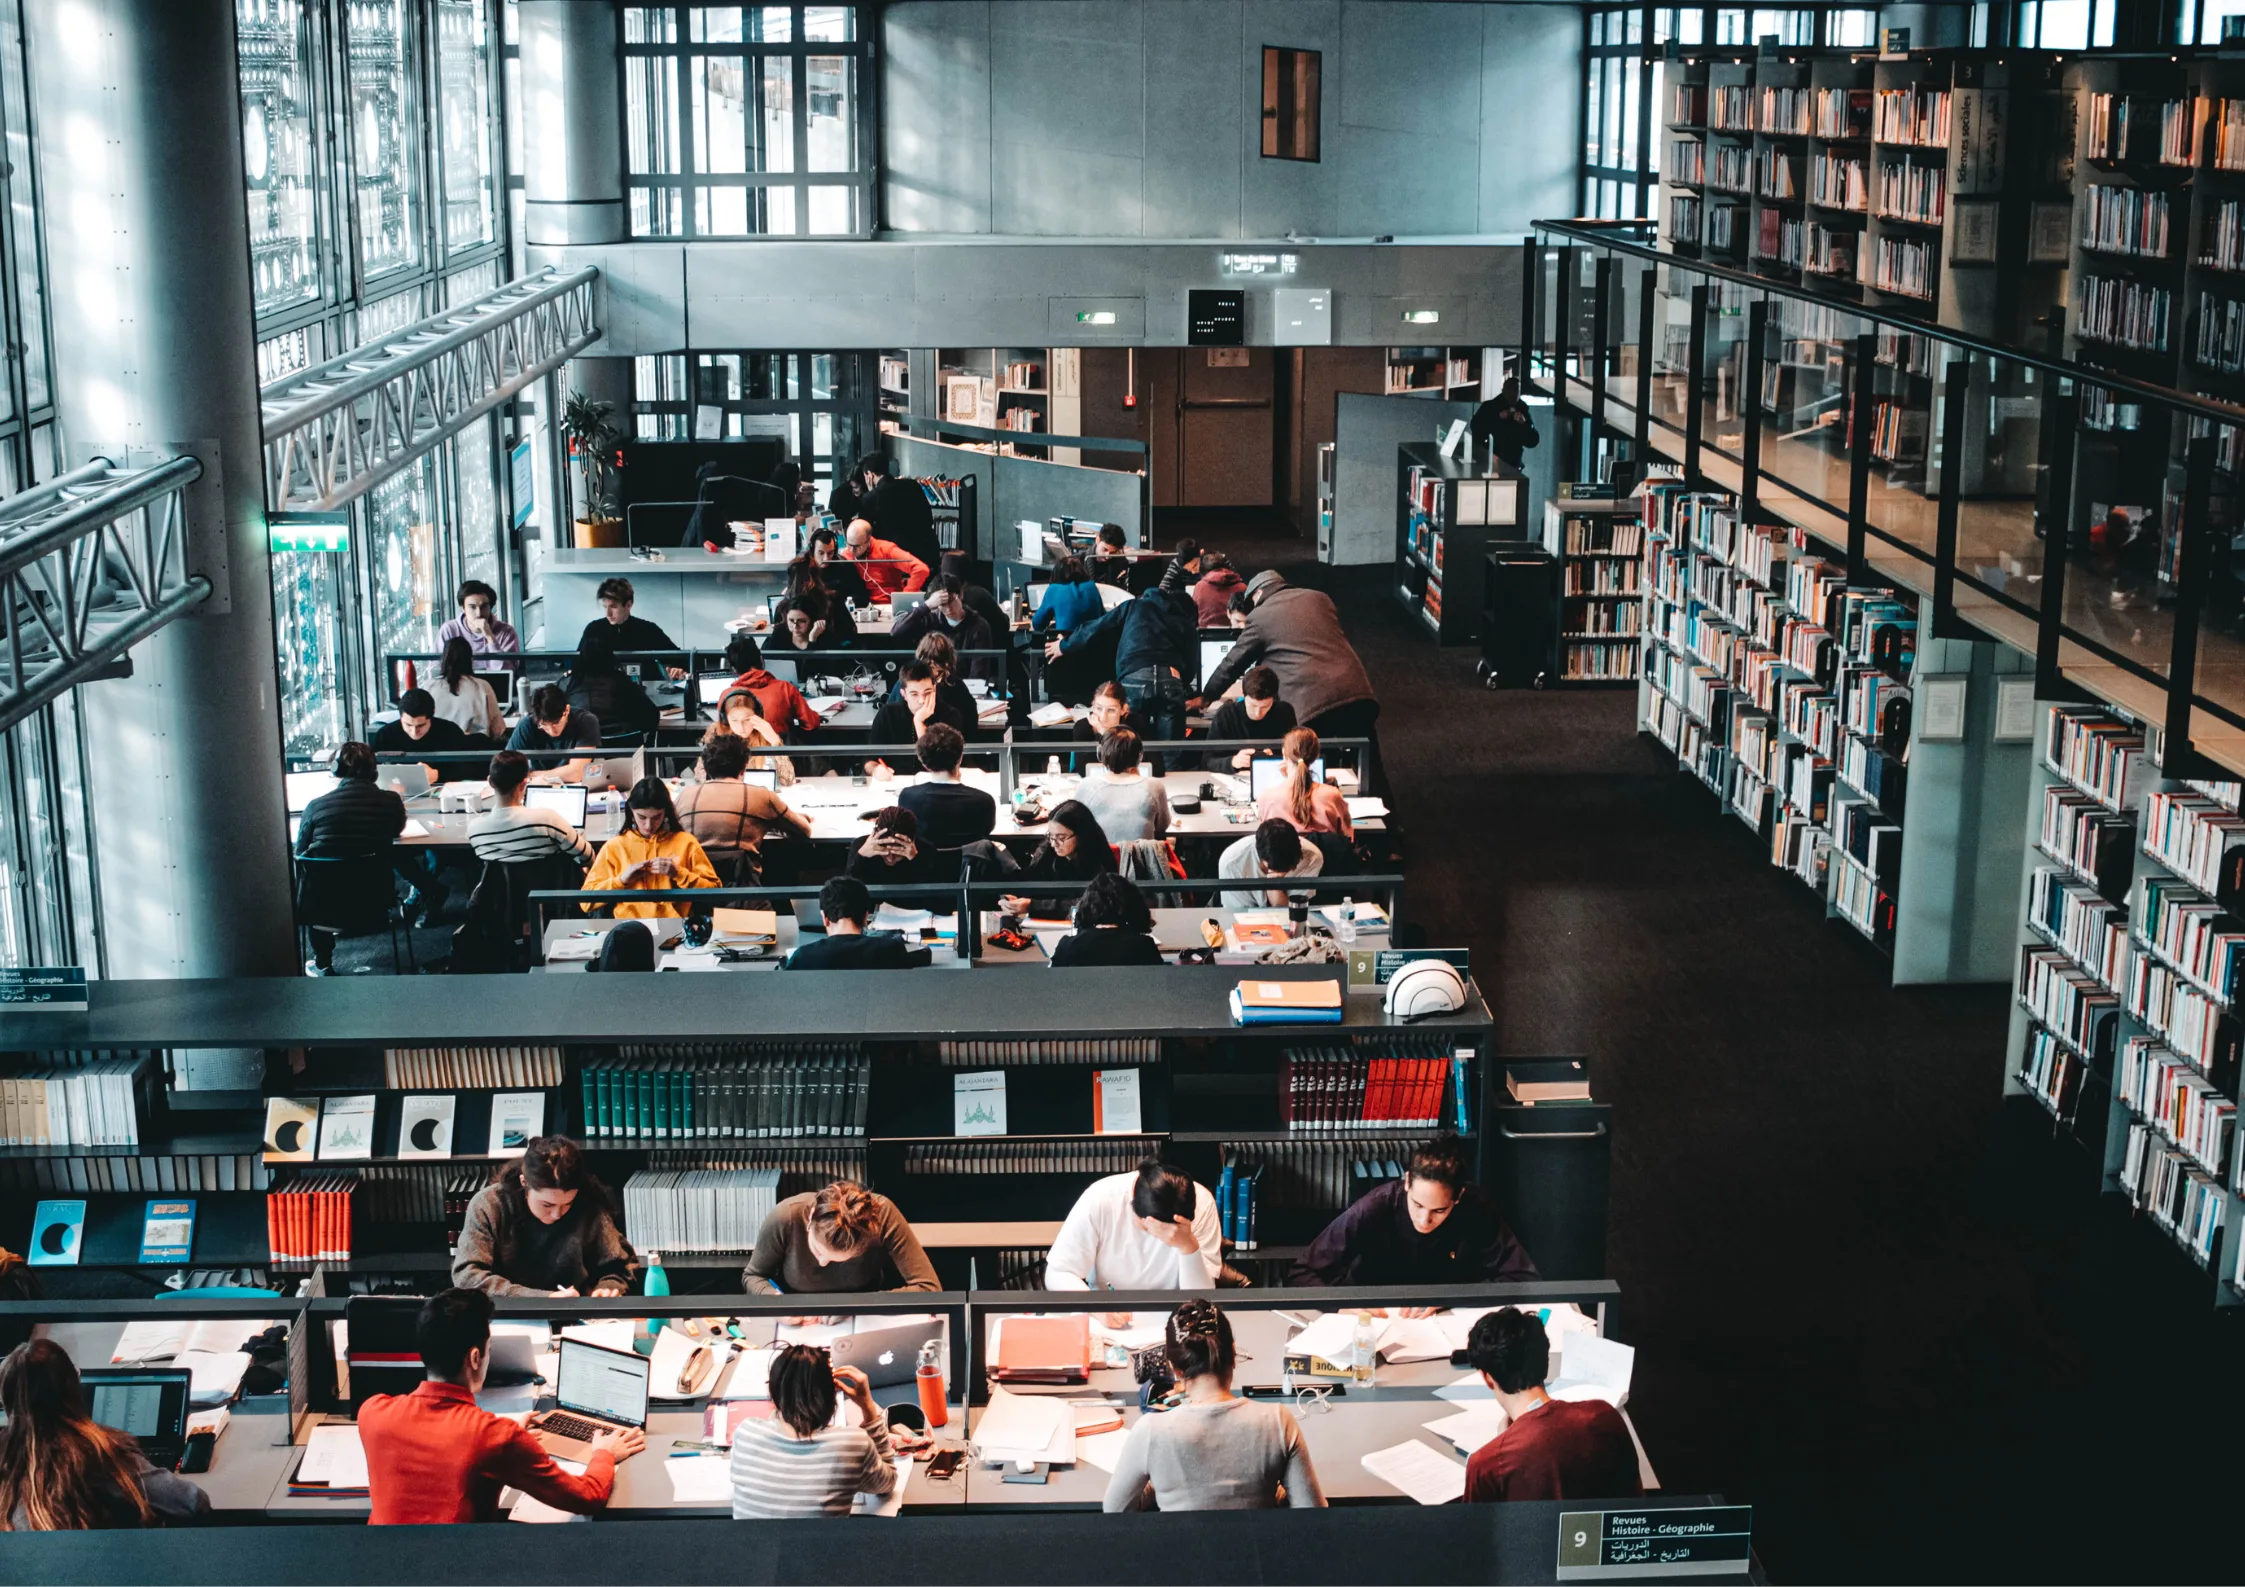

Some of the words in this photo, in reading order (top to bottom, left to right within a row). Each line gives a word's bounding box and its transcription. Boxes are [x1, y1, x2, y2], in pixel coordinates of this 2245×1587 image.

[1961, 95, 1971, 137] sociales
[1957, 139, 1969, 184] Sciences
[1357, 962, 1366, 973] 9
[28, 976, 63, 984] Géographie
[1096, 1075, 1131, 1083] RAWAFID
[1612, 1516, 1647, 1525] Revues
[1612, 1525, 1650, 1535] Histoire
[1658, 1523, 1715, 1535] Géographie
[1574, 1532, 1587, 1547] 9
[1611, 1540, 1650, 1551] الدوريات
[1610, 1550, 1650, 1563] الجغرافية
[1660, 1548, 1690, 1562] التاريخ
